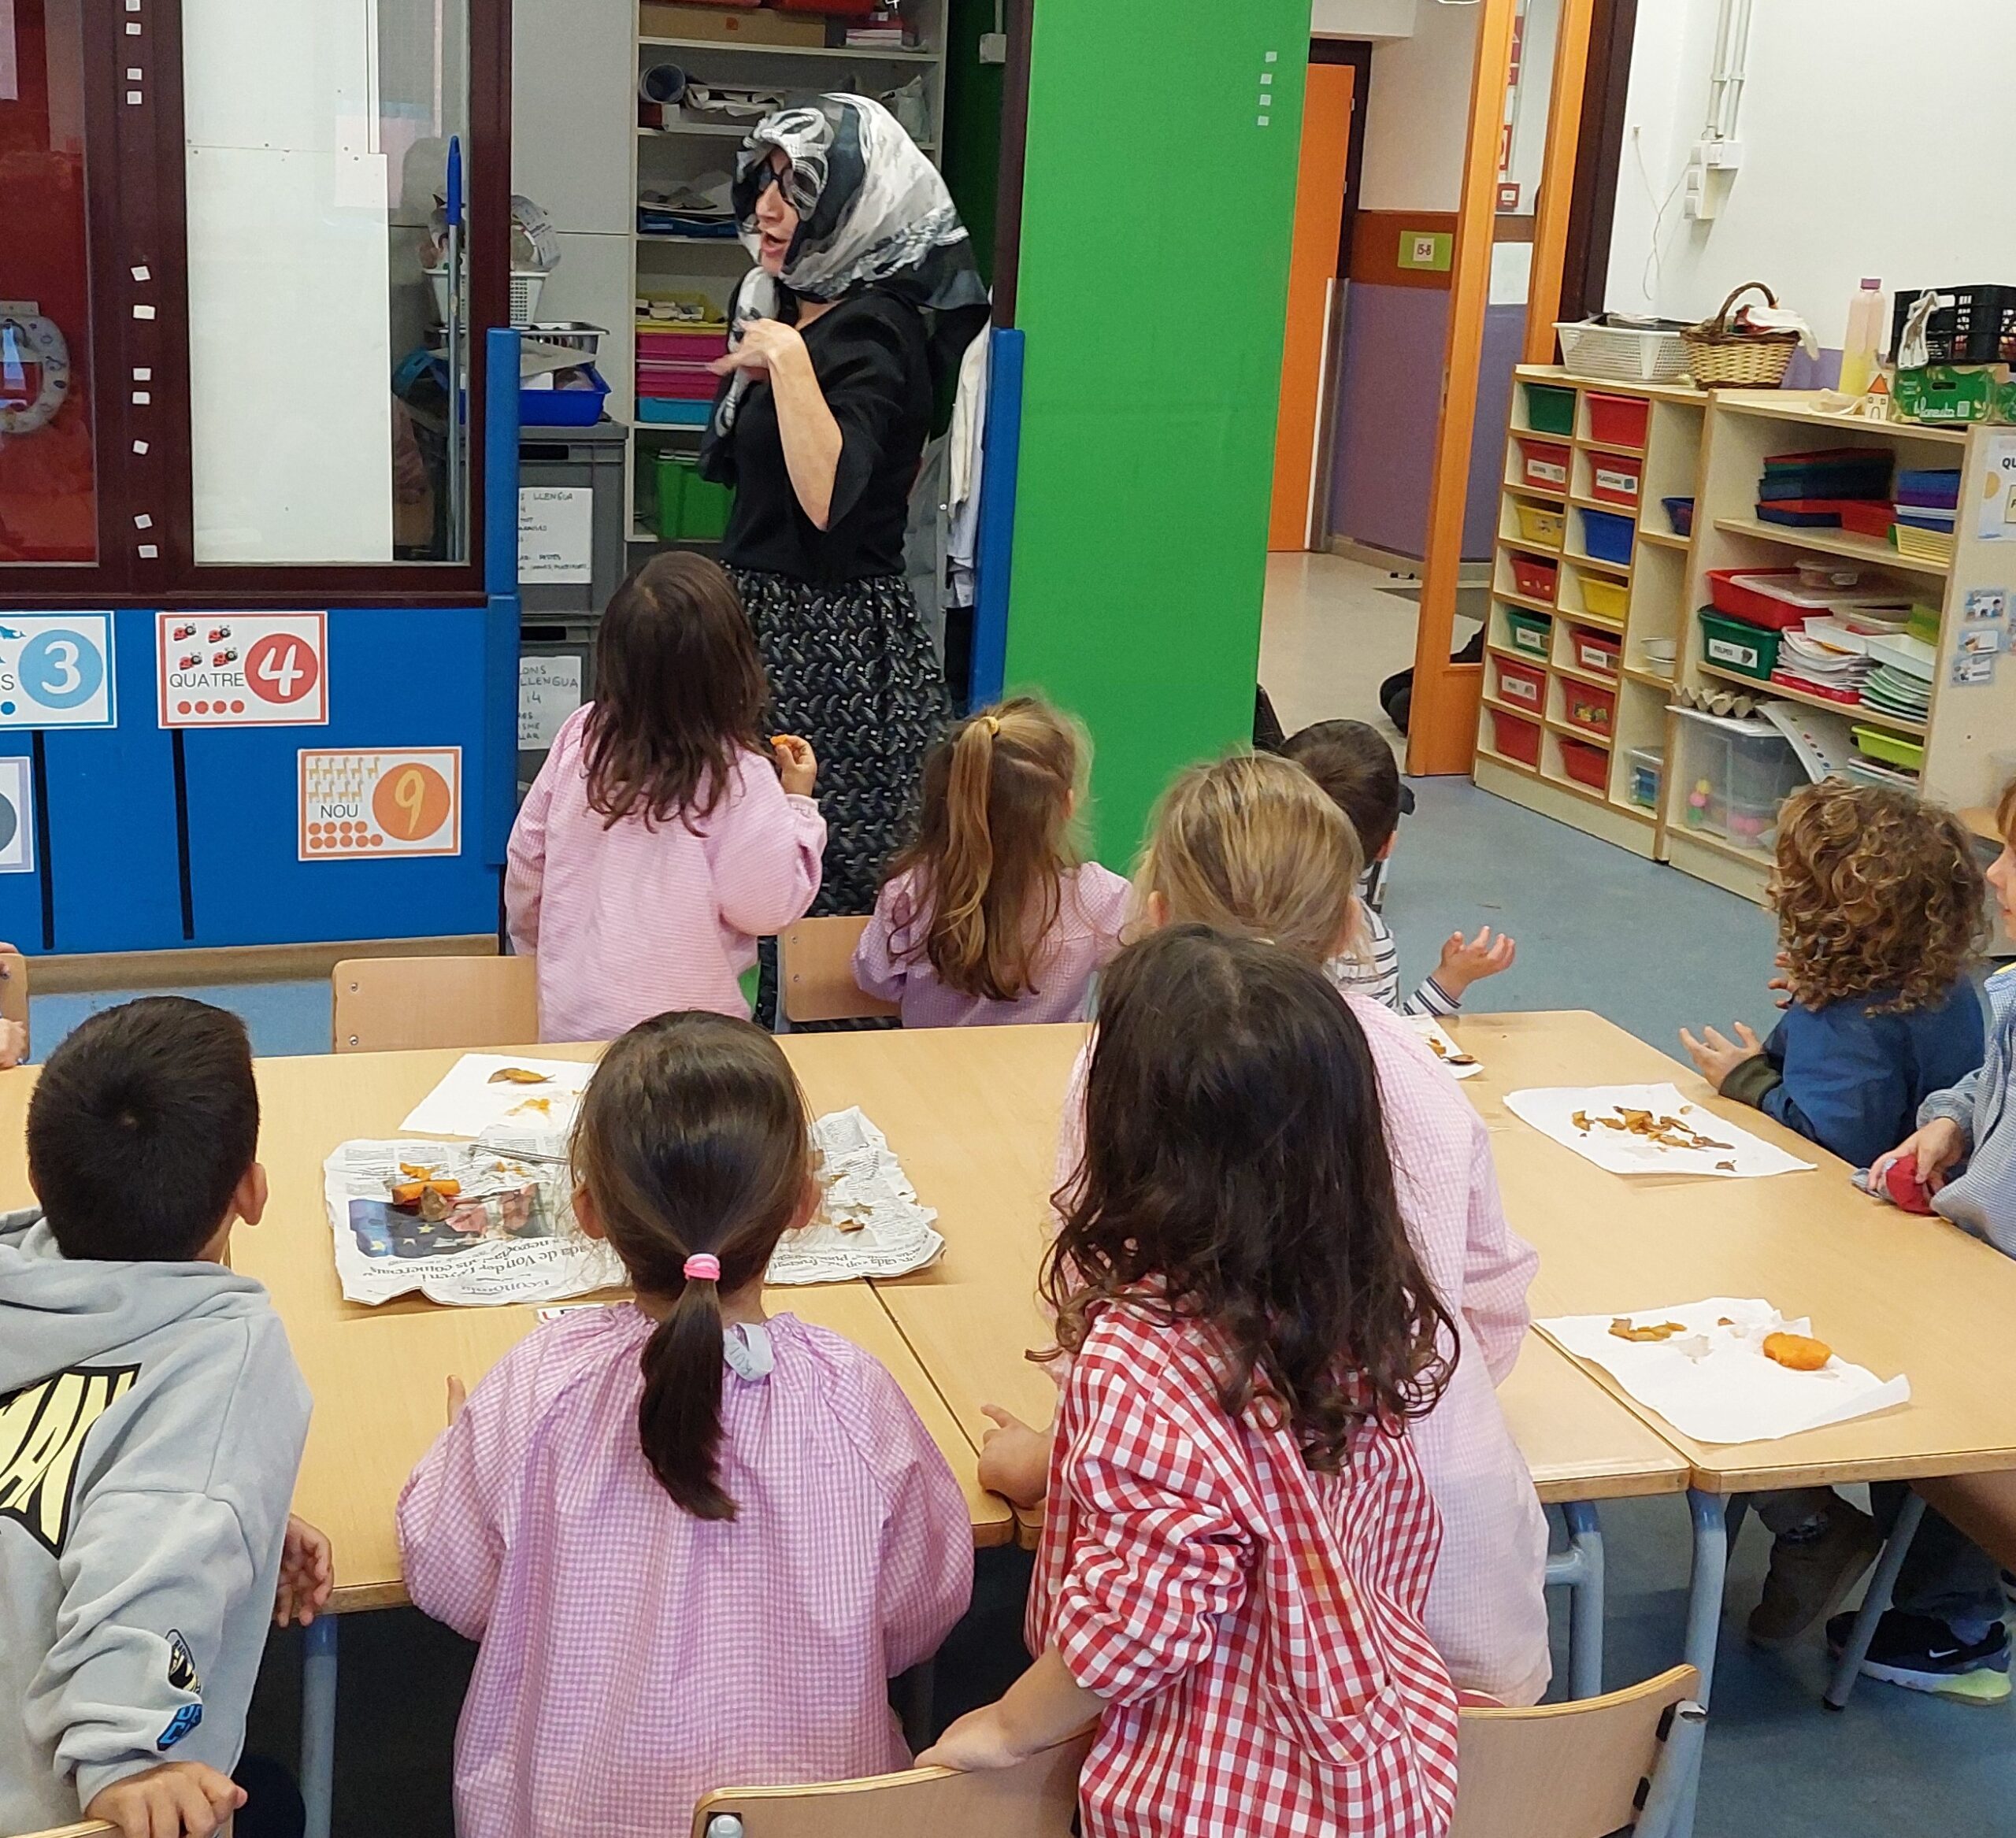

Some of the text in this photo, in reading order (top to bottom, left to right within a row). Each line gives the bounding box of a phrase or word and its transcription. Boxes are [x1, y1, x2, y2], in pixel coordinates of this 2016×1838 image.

[41, 640, 81, 695] 3
[258, 643, 304, 697] 4
[169, 673, 244, 687] QUATRE
[520, 675, 579, 688] LLENGUA
[395, 769, 426, 836] 9
[320, 804, 359, 819] NOU
[506, 1255, 536, 1269] Von
[538, 1250, 558, 1262] de
